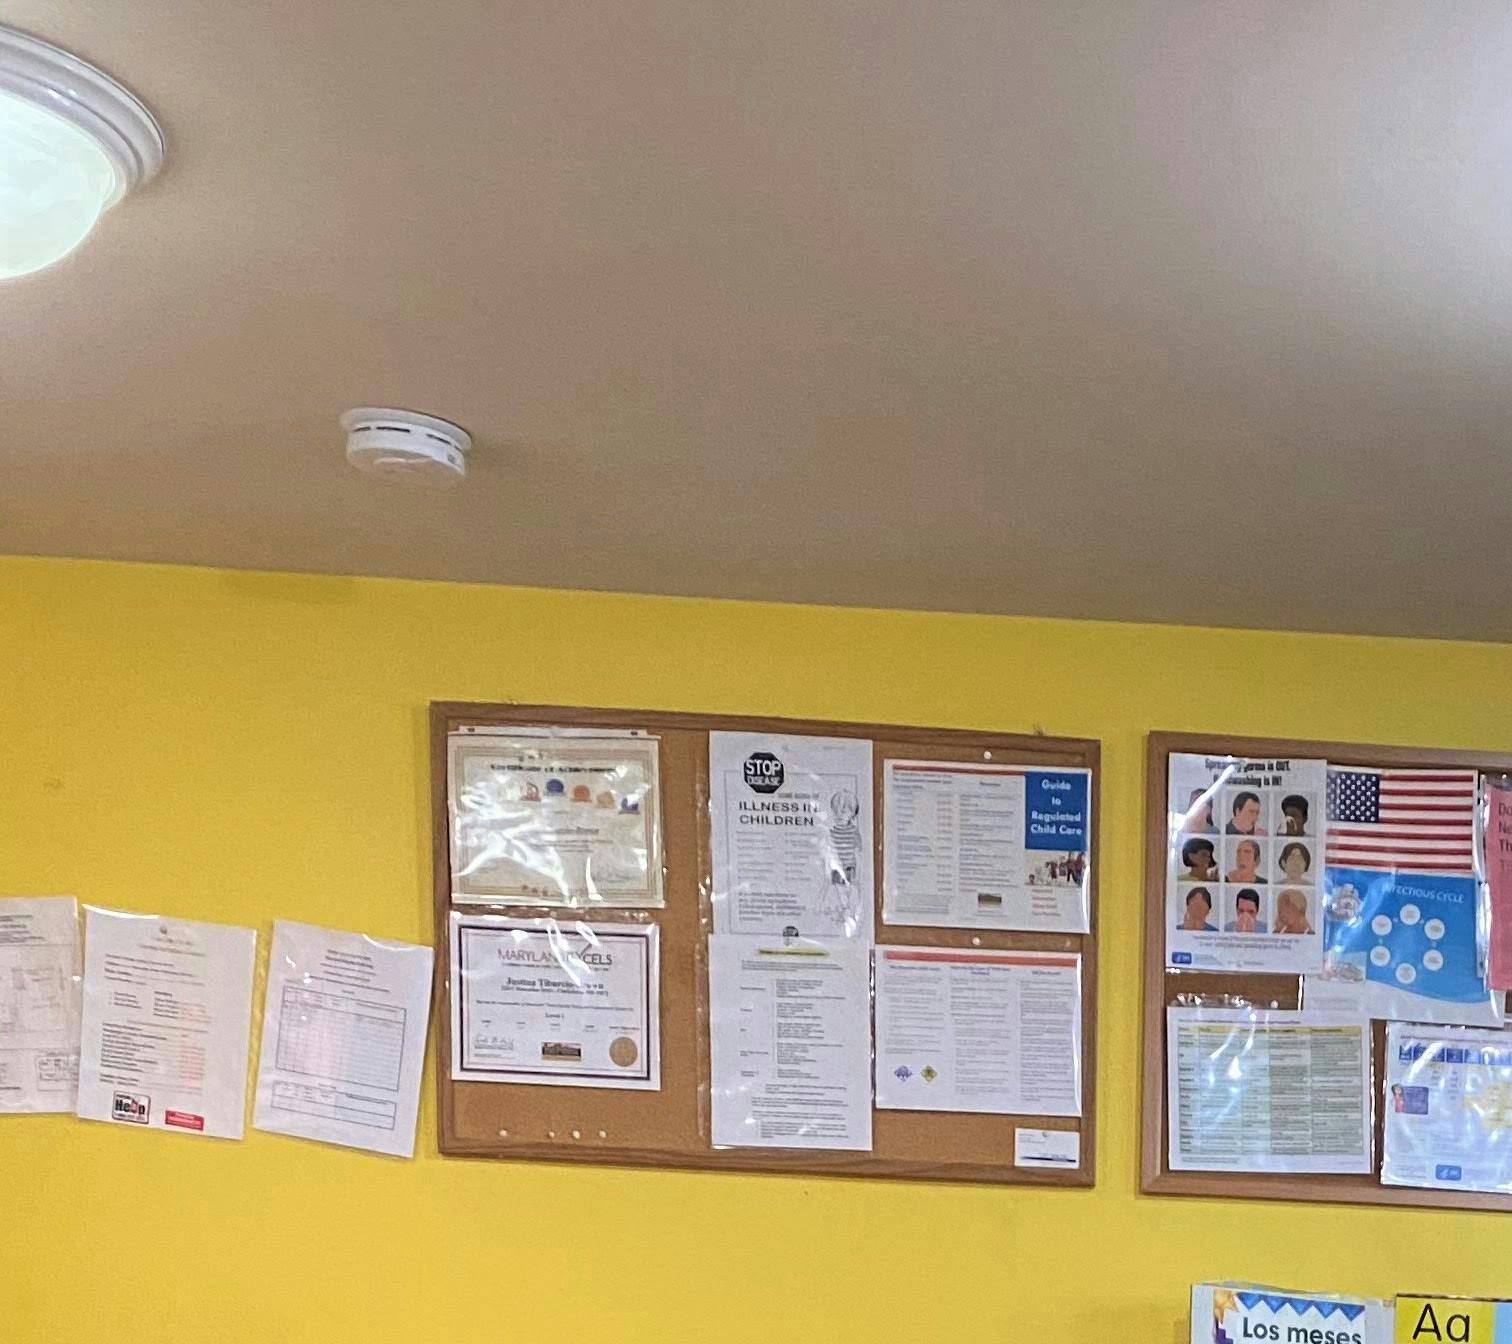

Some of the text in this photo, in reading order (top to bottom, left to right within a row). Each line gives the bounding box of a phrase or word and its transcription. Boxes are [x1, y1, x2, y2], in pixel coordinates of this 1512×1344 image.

[745, 760, 782, 775] STOP
[1042, 779, 1072, 790] Guide
[1051, 796, 1061, 805] to
[739, 801, 799, 813] ILLNESS
[739, 815, 815, 826] CHILDREN
[1031, 810, 1081, 823] Regulated
[1030, 824, 1082, 835] Child Care
[1437, 890, 1465, 903] CYCLE
[1243, 1317, 1280, 1340] Los
[1412, 1303, 1471, 1342] Aa
